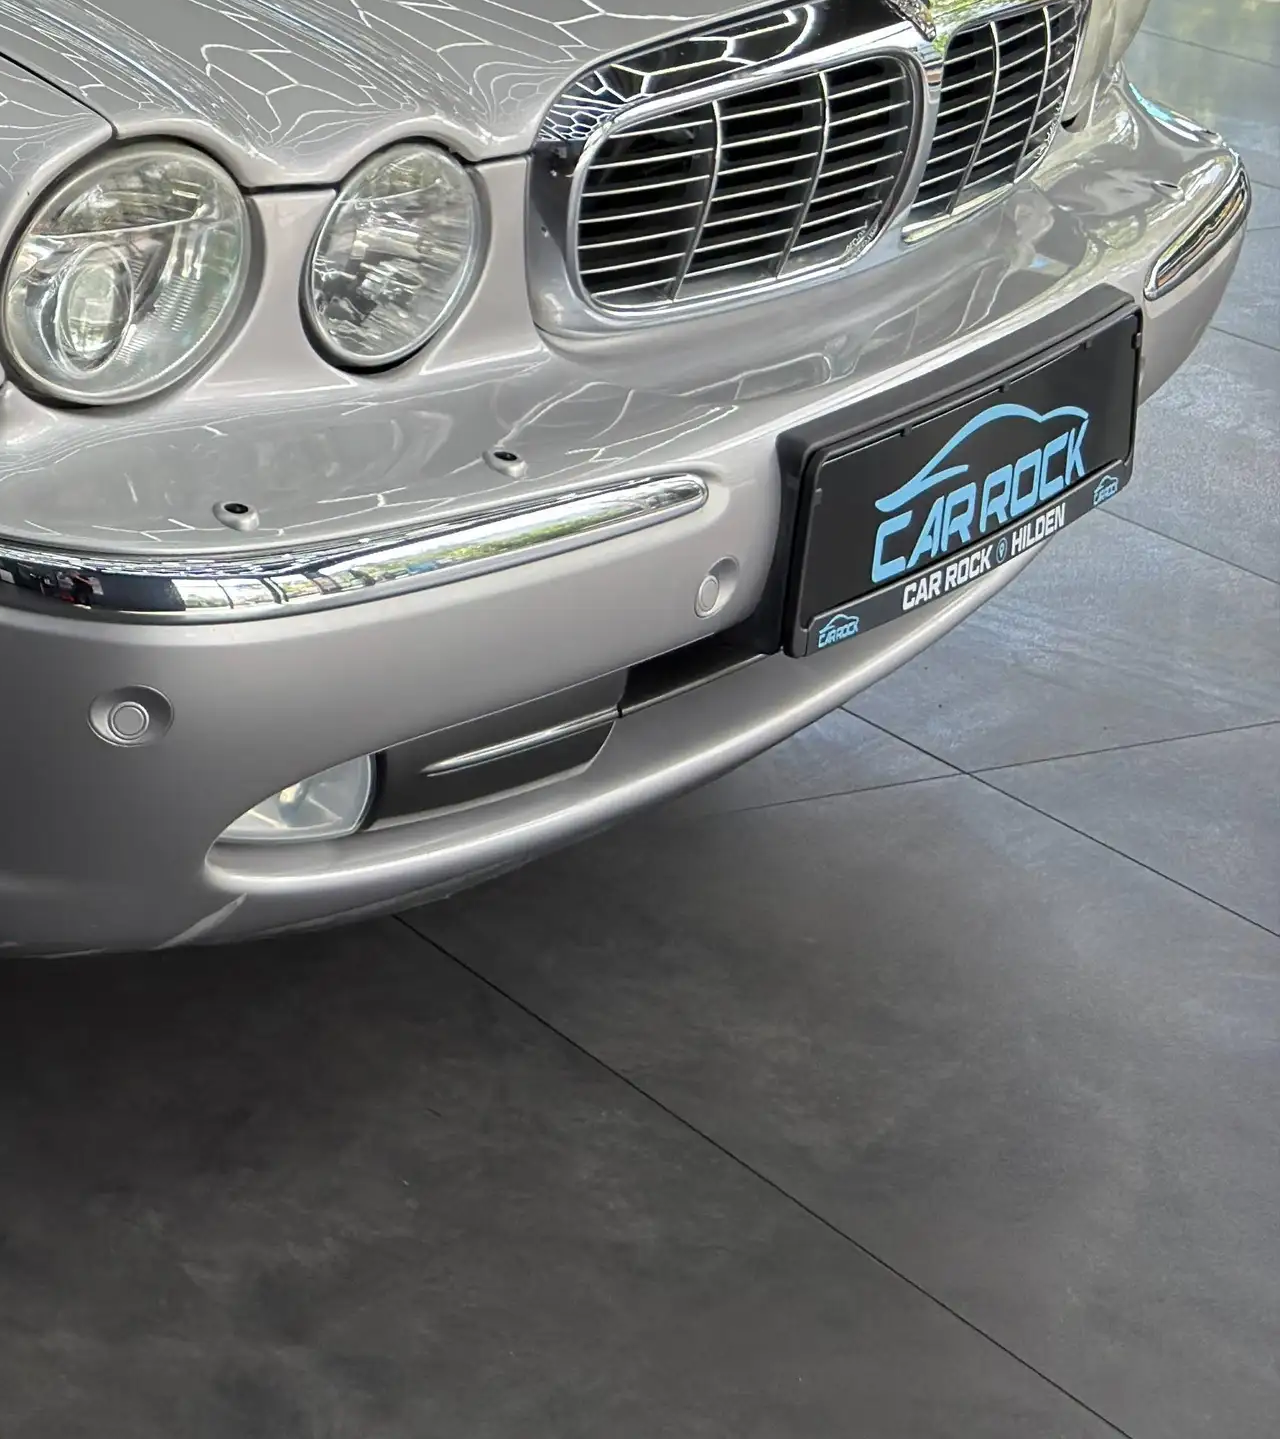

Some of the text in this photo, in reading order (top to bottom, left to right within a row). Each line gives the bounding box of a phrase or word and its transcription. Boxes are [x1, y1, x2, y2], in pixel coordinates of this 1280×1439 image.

[871, 420, 1089, 584] CAR ROCK
[902, 502, 1066, 610] CAR ROCK HILDEN
